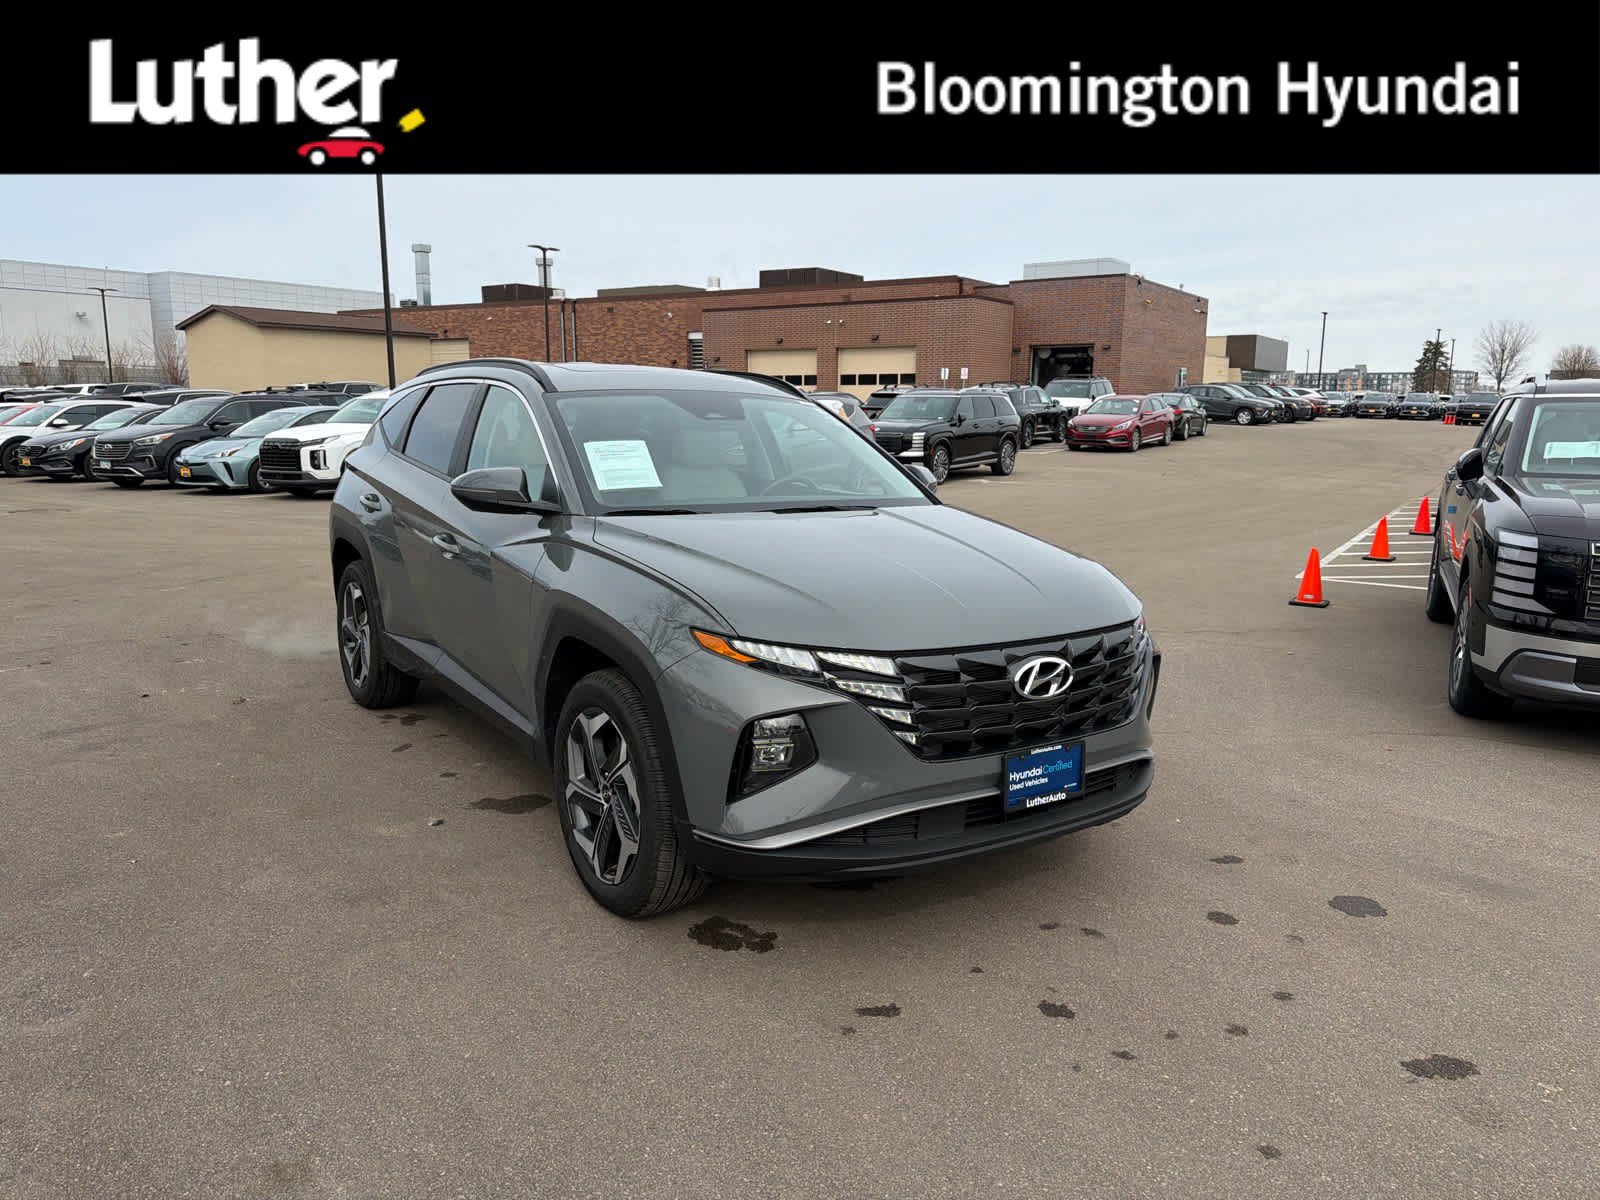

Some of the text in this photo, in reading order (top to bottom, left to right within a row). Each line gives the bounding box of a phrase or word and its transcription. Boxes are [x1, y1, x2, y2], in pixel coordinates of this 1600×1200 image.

[1009, 777, 1048, 791] Used Vehicles
[1026, 792, 1067, 808] LutherAuto
